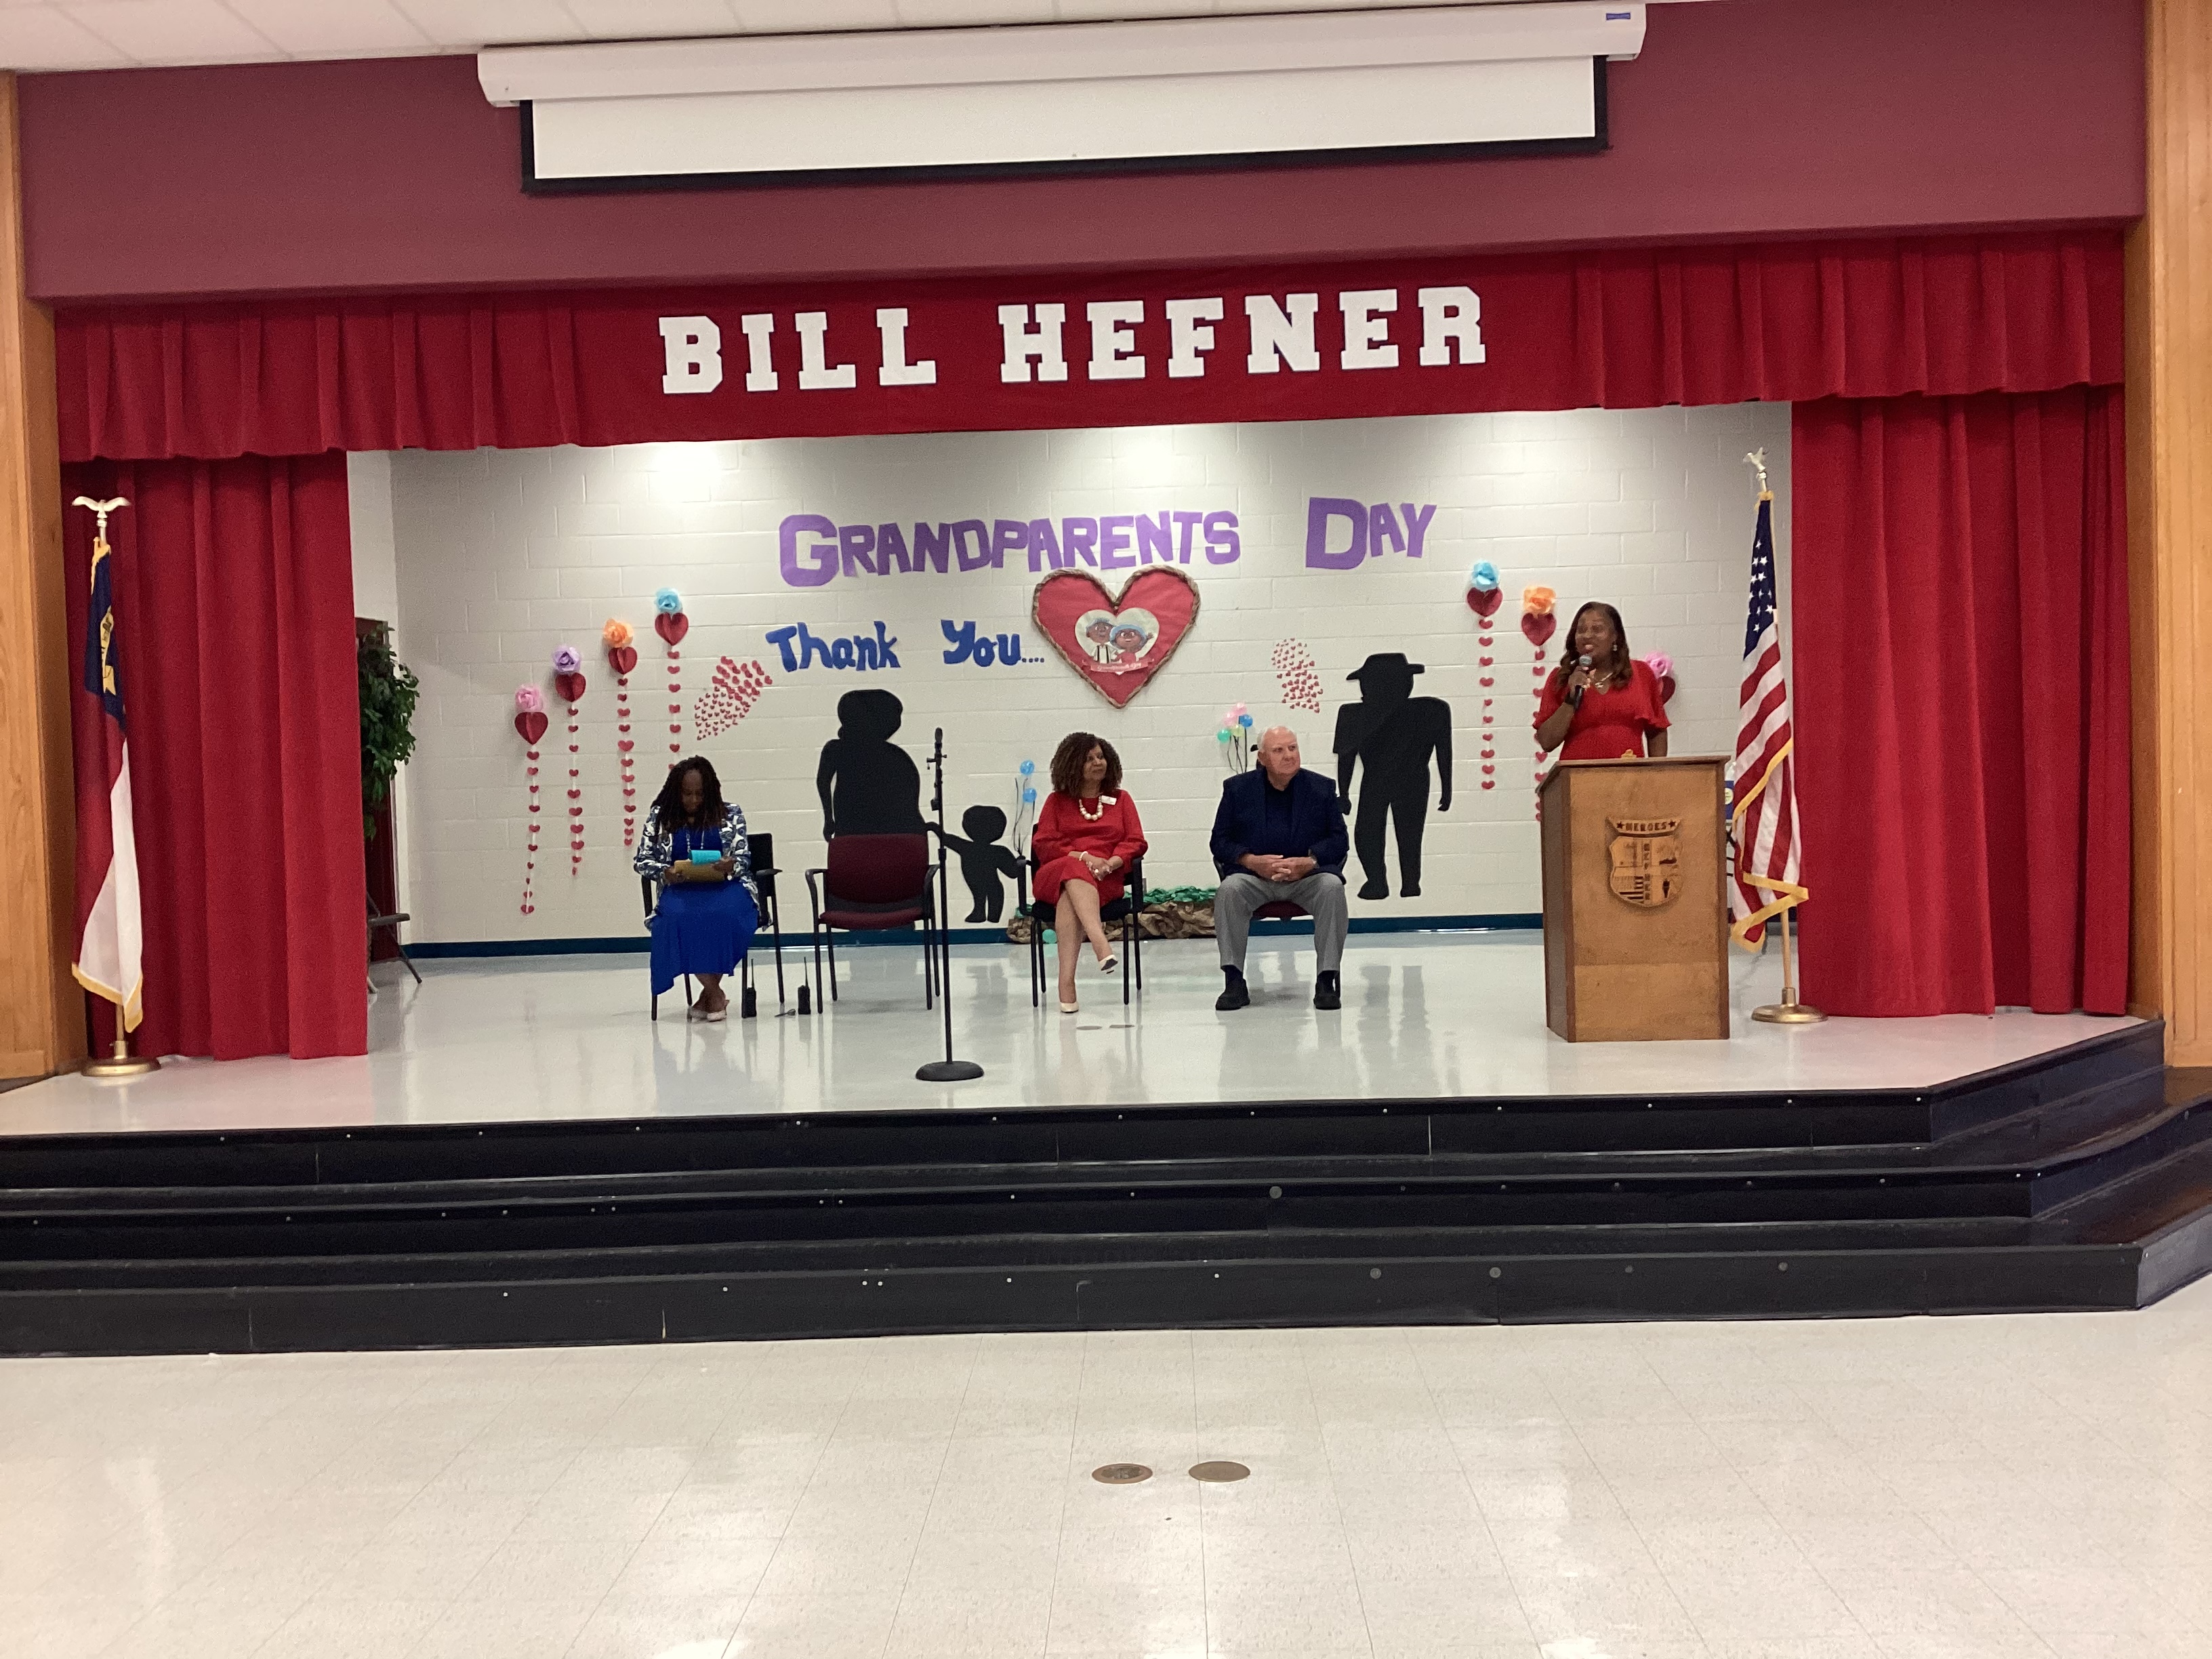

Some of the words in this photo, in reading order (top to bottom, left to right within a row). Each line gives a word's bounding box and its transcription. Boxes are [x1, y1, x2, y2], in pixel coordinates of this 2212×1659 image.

[659, 308, 937, 394] BILL
[998, 286, 1487, 384] HEFNER
[779, 510, 1241, 588] GRANDPARENTS
[1305, 497, 1437, 570] DAY
[765, 620, 901, 672] Thank
